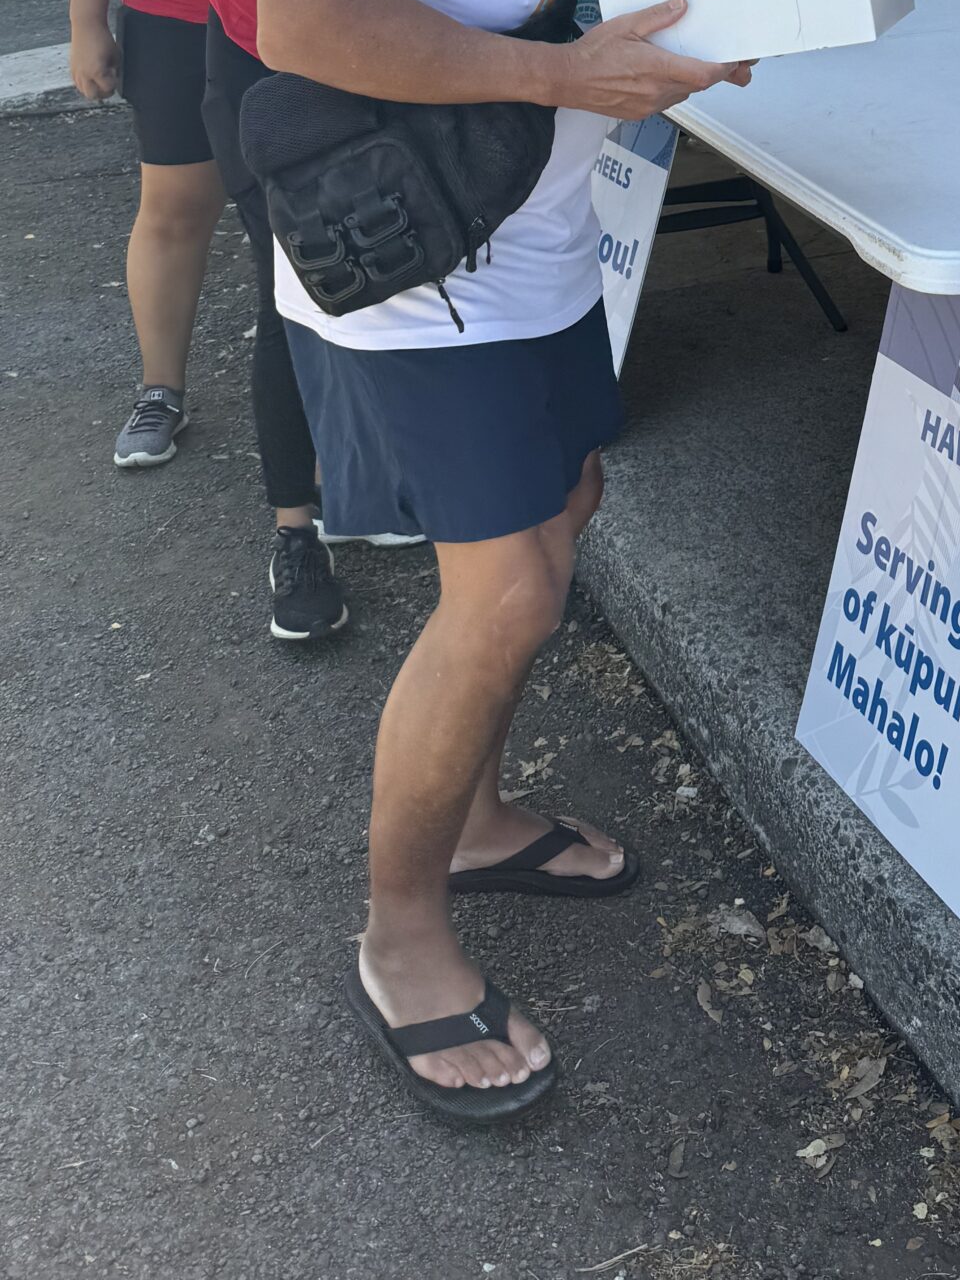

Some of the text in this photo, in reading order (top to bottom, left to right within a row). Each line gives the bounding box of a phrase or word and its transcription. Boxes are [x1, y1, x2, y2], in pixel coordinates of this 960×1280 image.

[598, 230, 639, 280] ou!
[843, 588, 877, 634] of
[827, 641, 948, 790] Mahalo!
